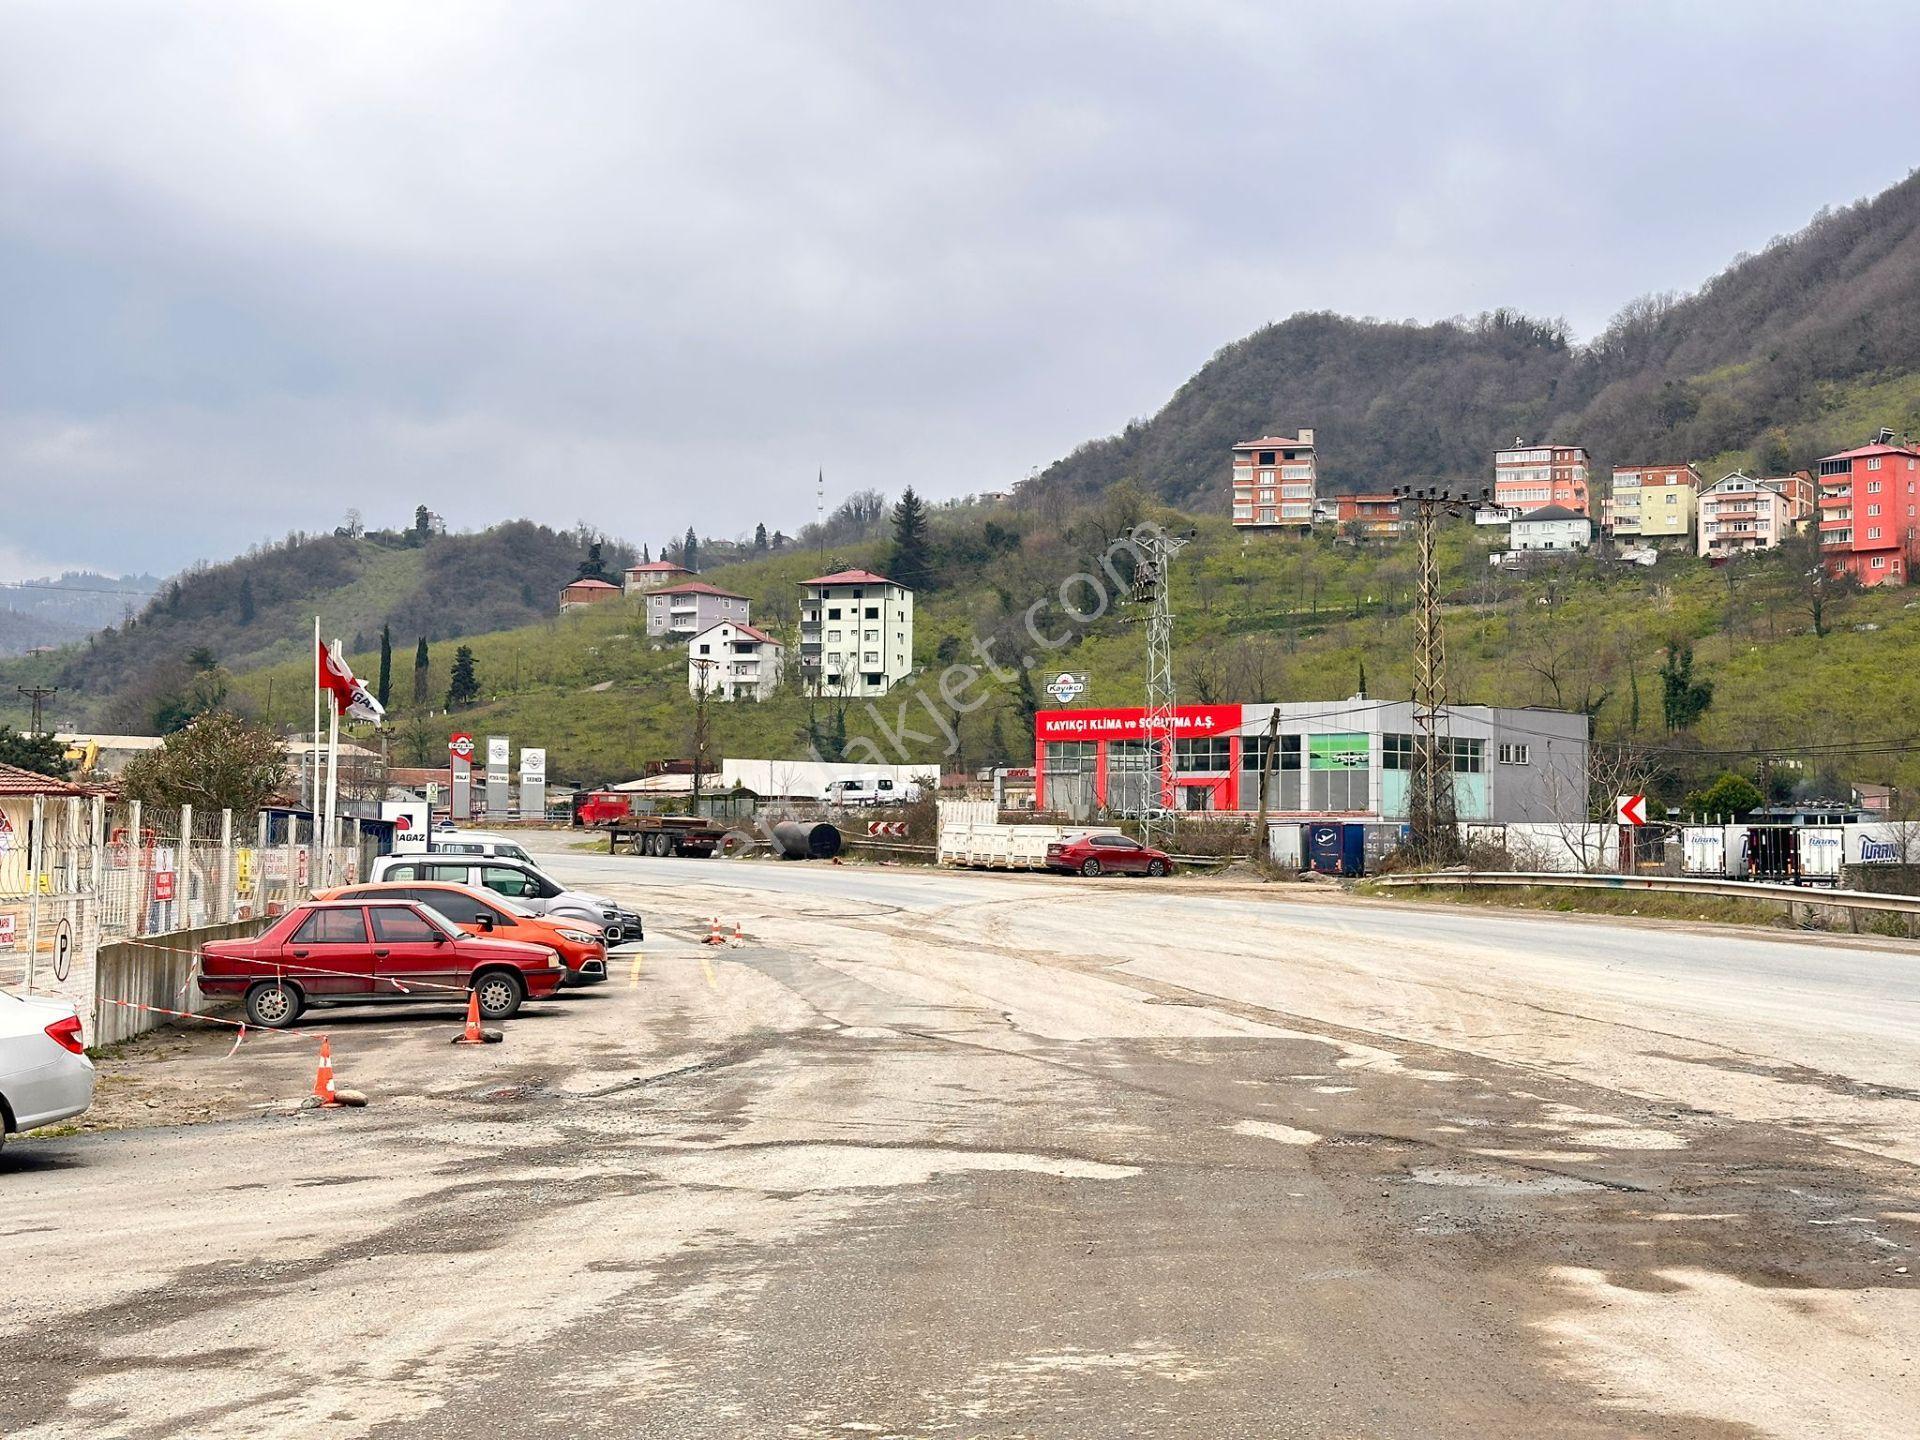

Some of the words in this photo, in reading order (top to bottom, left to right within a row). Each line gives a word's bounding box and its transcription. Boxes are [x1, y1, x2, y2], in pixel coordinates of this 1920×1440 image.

[1046, 719, 1087, 732] KAYIKÇI
[1089, 718, 1122, 730] KLİMA
[1125, 720, 1136, 729] ve
[1194, 715, 1215, 729] A.Ş.
[396, 833, 426, 842] AGAZ
